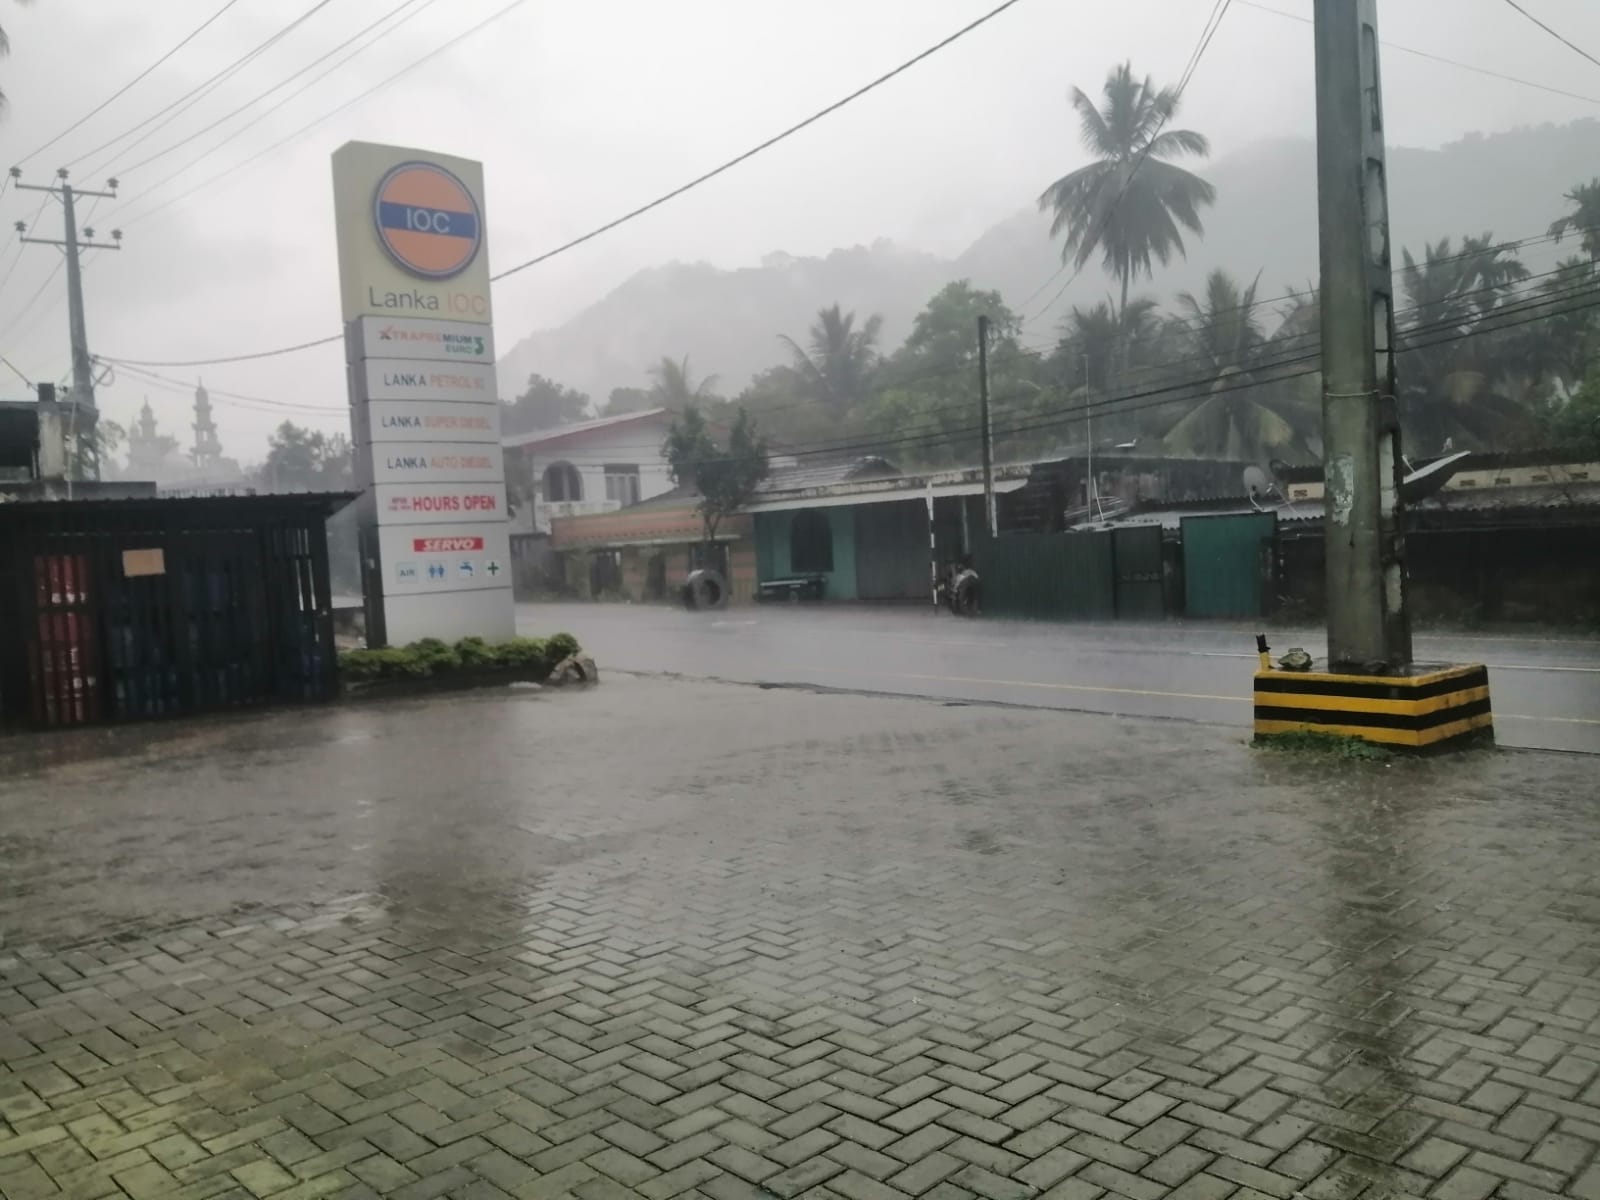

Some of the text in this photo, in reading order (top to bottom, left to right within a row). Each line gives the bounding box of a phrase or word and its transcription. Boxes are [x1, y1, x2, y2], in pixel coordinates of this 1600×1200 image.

[406, 207, 450, 233] IOC
[369, 286, 487, 315] Lanka IOC
[383, 373, 427, 387] LANKA
[381, 415, 422, 428] LANKA
[387, 456, 428, 469] LANKA
[412, 496, 460, 511] HOURS
[463, 495, 496, 510] OPEN
[423, 538, 475, 551] SERVO
[399, 569, 416, 577] AIR
